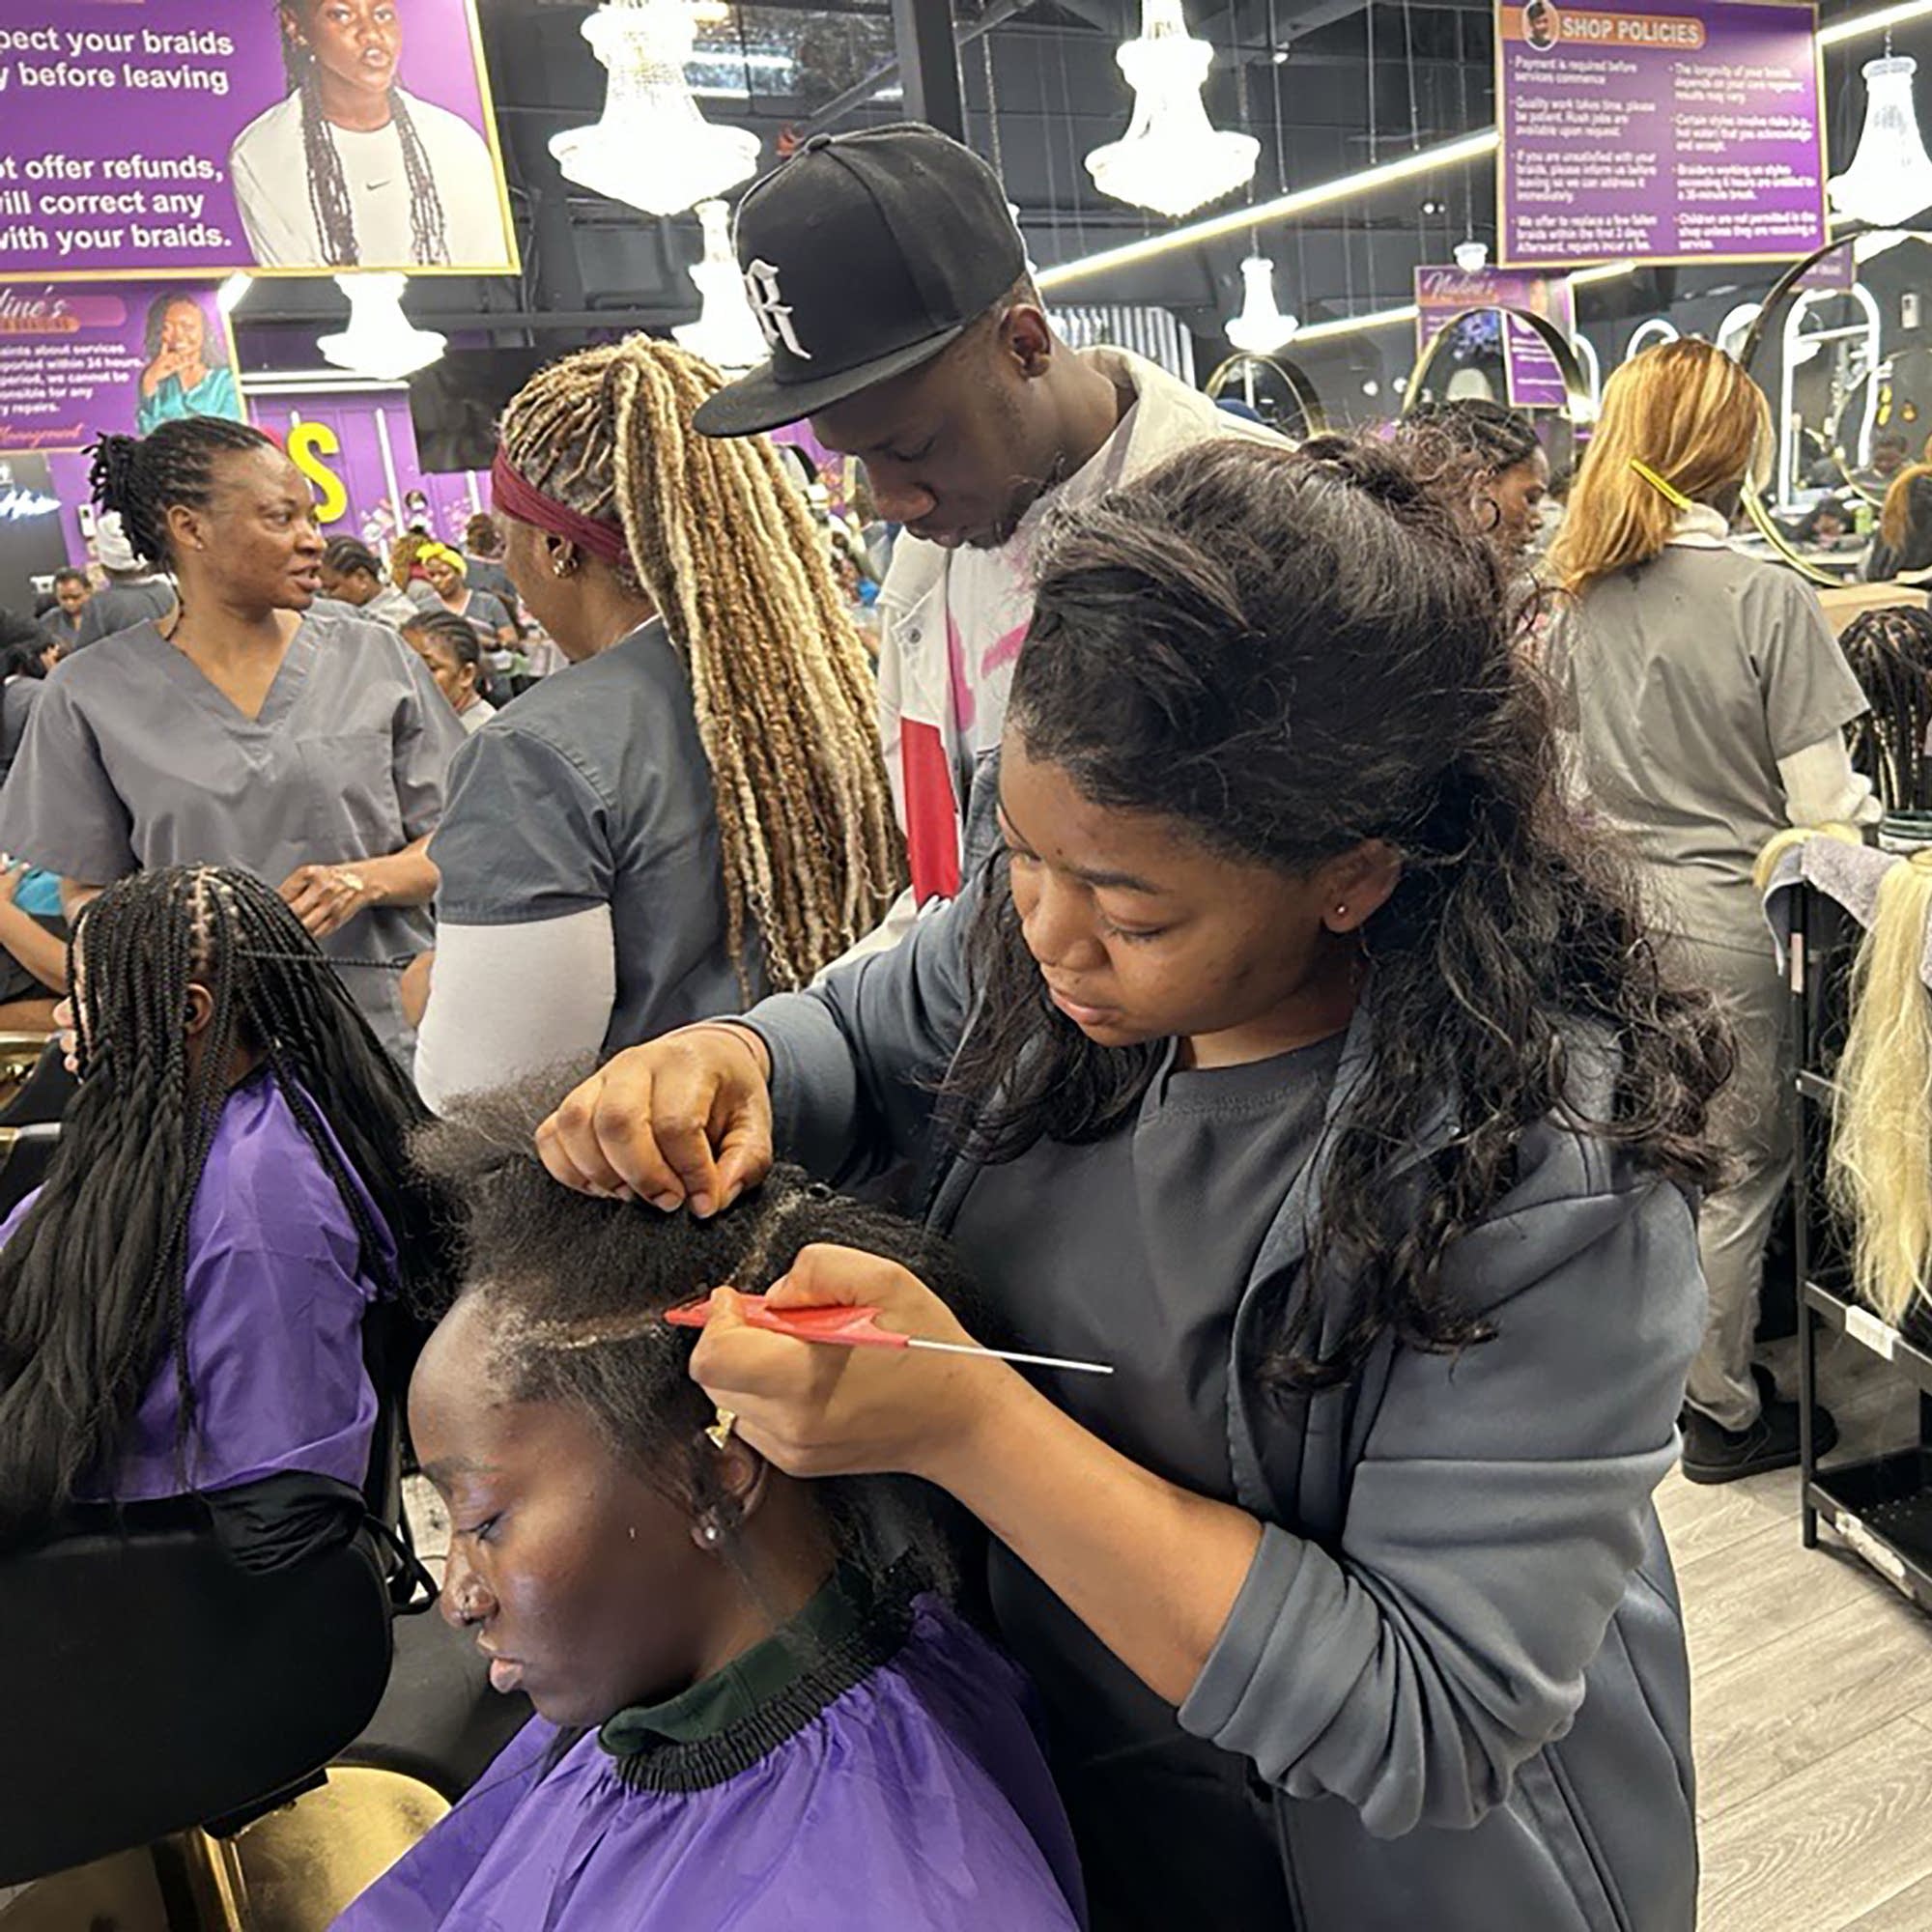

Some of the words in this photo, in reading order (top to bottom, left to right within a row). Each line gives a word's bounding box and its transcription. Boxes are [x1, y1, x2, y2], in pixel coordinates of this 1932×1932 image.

[68, 31, 135, 57] your
[143, 29, 234, 55] braids
[1562, 16, 1613, 39] SHOP
[1617, 19, 1699, 43] POLICIES
[18, 62, 115, 88] before
[124, 64, 229, 96] leaving
[0, 156, 18, 180] t
[25, 155, 95, 180] offer
[102, 155, 223, 183] refunds,
[0, 190, 32, 214] ill
[40, 191, 147, 214] correct
[153, 194, 205, 219] any
[56, 229, 124, 255] your
[130, 223, 232, 248] braids.
[72, 342, 126, 355] services
[113, 371, 129, 383] be
[70, 387, 93, 400] any
[288, 421, 348, 523] S
